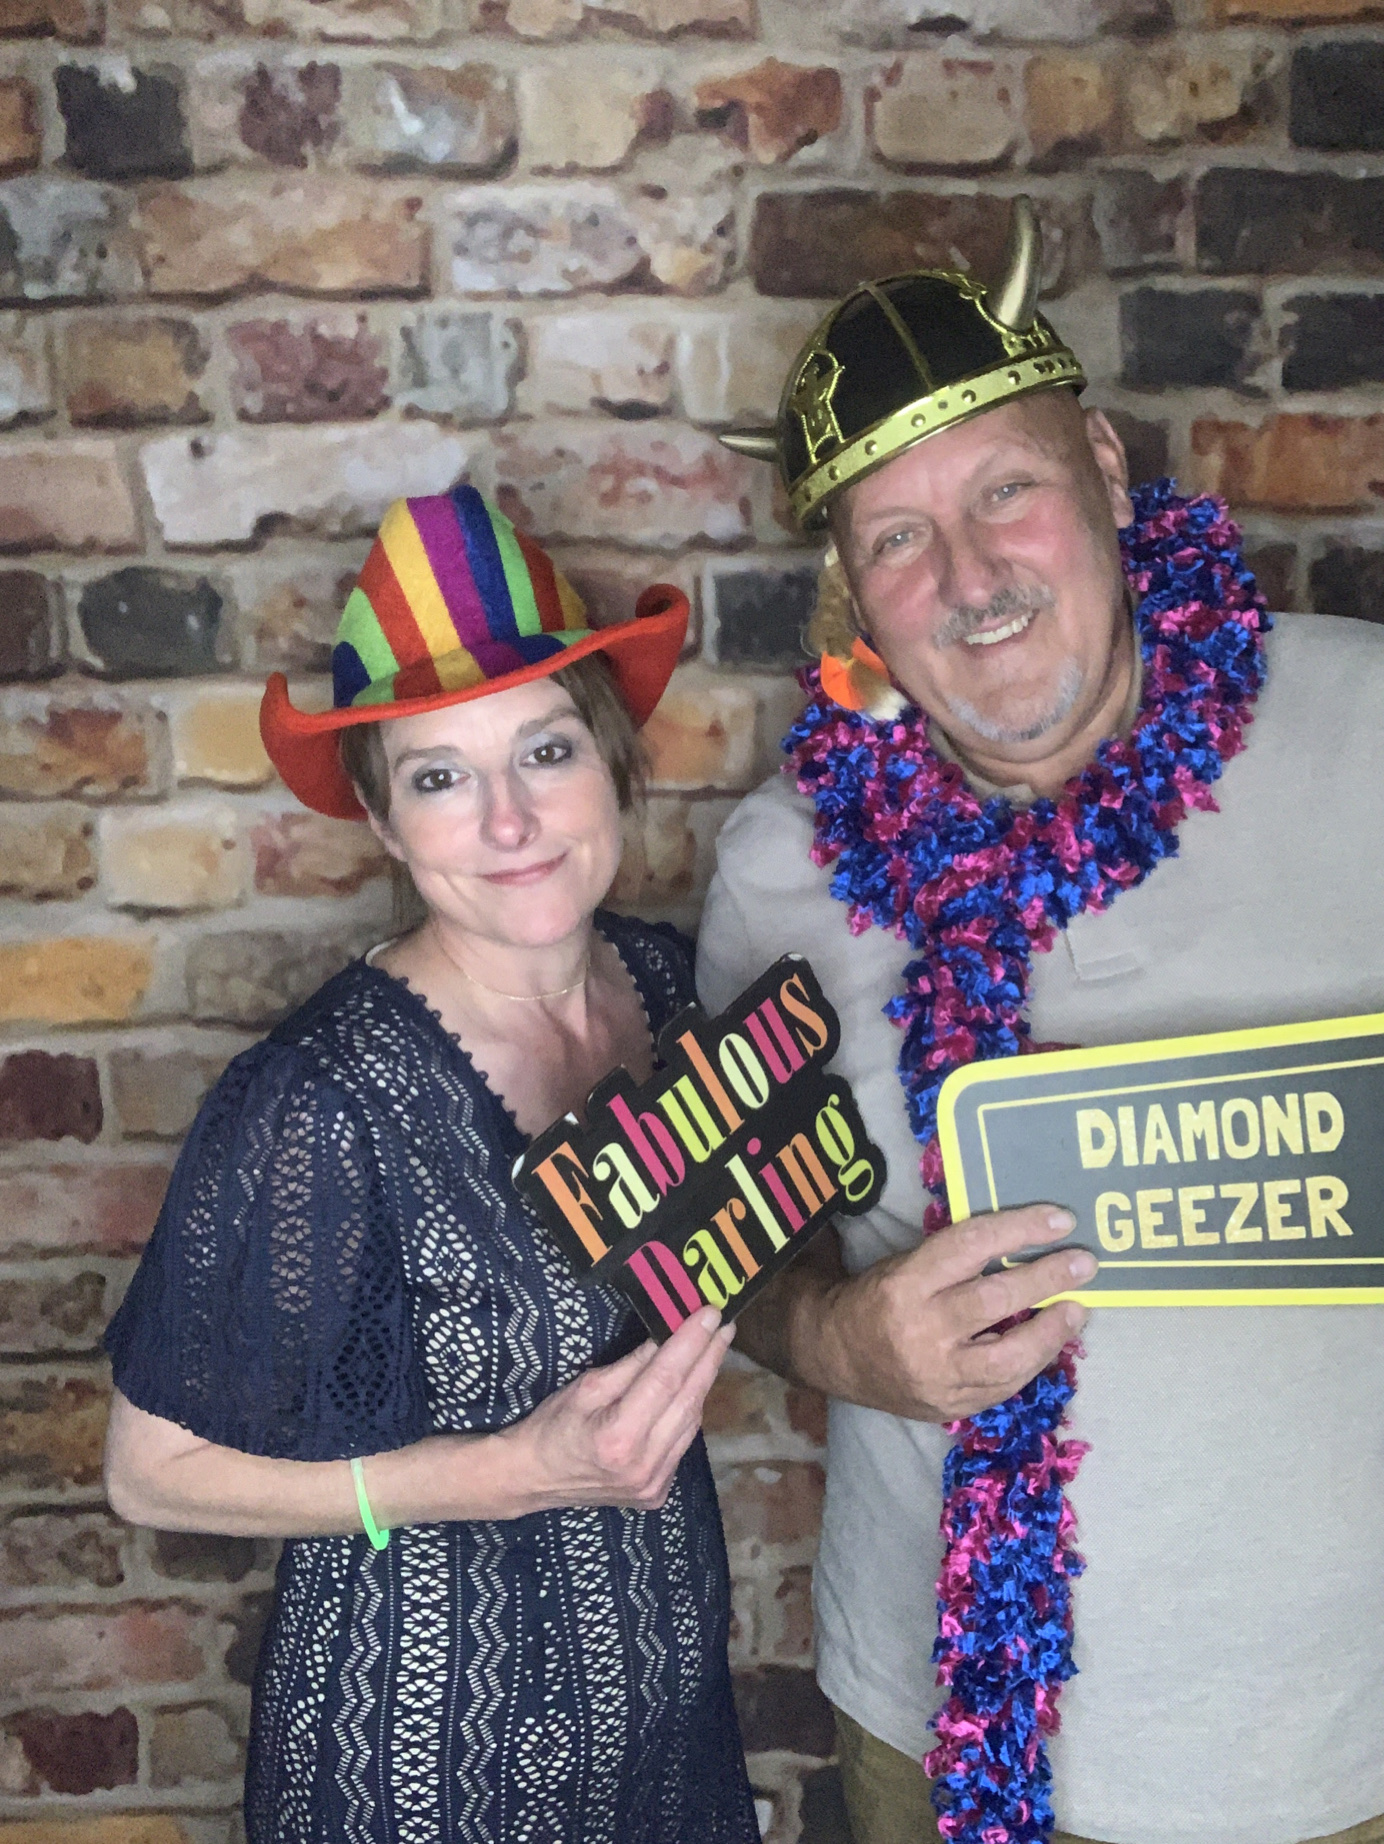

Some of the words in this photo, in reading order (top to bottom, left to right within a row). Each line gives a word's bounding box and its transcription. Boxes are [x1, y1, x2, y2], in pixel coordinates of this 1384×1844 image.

[531, 973, 828, 1267] Fabulous
[1076, 1091, 1345, 1169] DIAMOND
[623, 1093, 875, 1333] Darling
[1095, 1175, 1354, 1252] GEEZER
